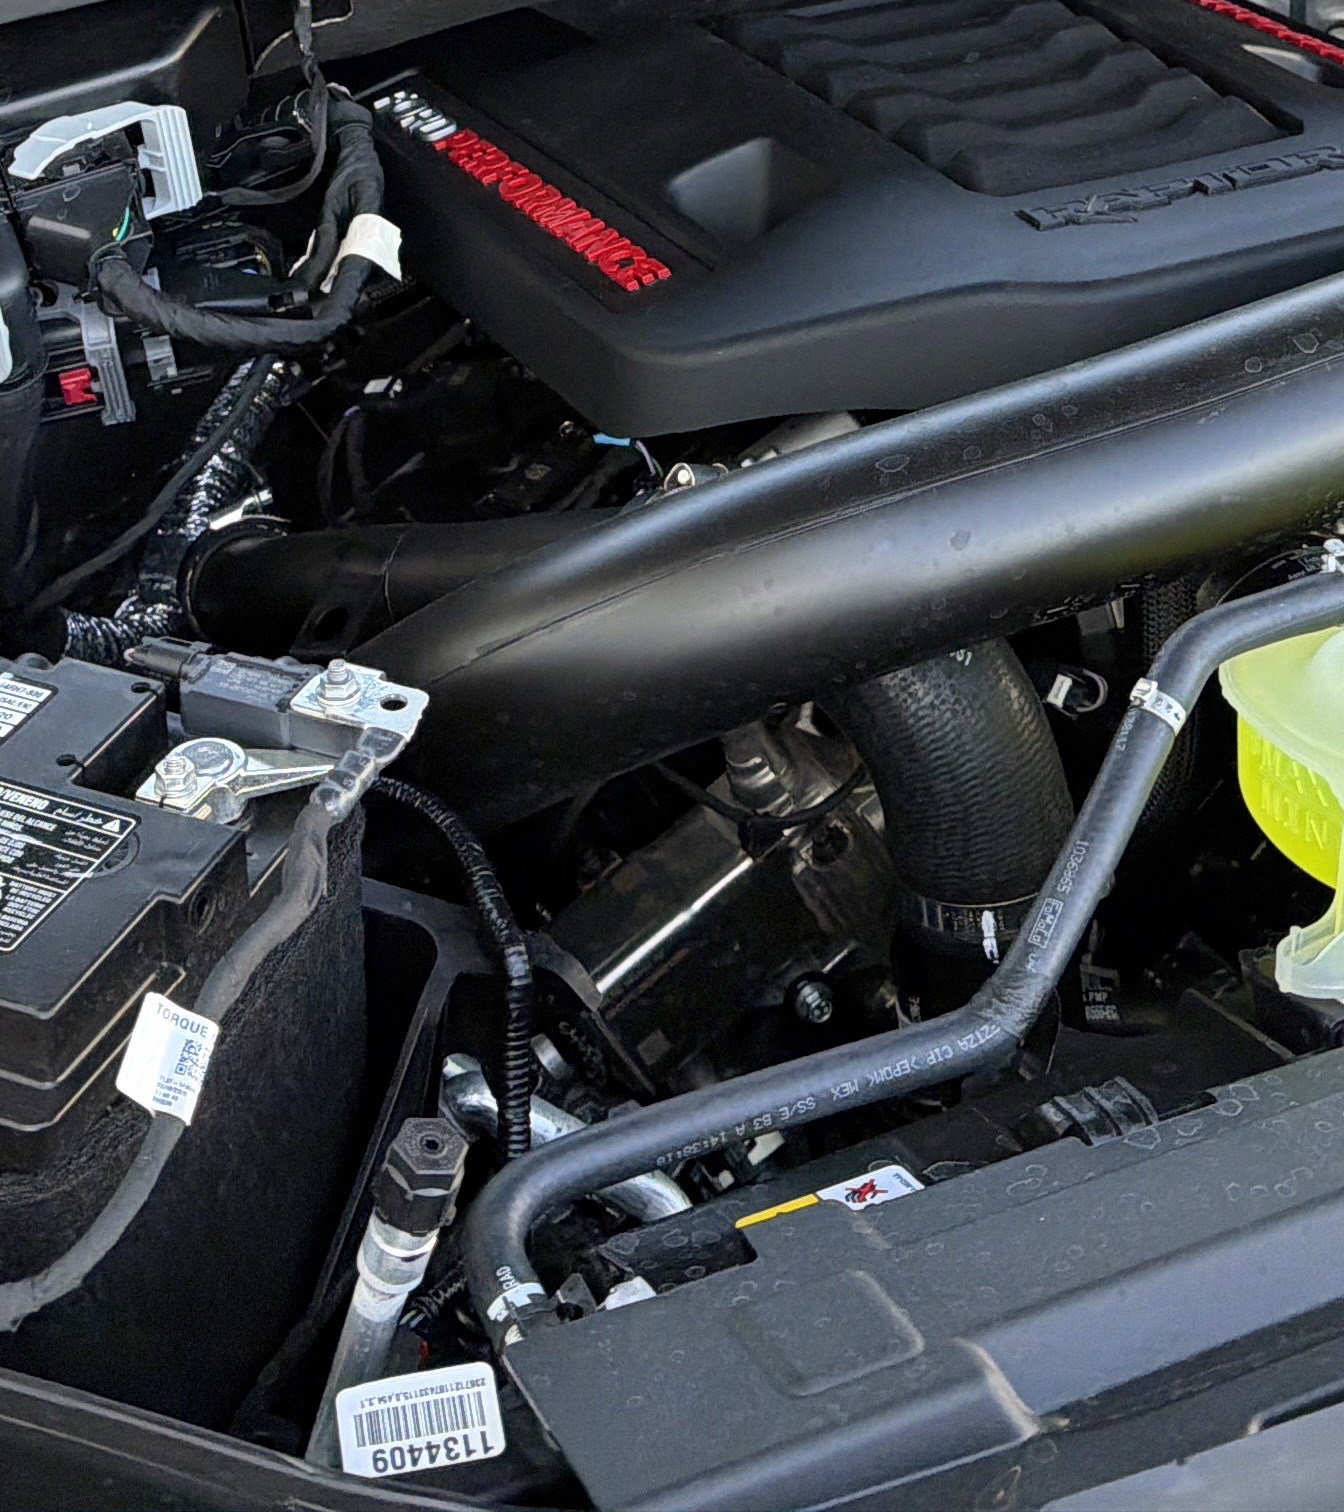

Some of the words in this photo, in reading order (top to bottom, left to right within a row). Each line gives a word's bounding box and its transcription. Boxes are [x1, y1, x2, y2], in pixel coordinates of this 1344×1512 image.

[433, 128, 673, 292] PERFORMANCE
[156, 1003, 209, 1038] TORQUE
[826, 1075, 862, 1102] MEX
[371, 1430, 495, 1474] 1134409
